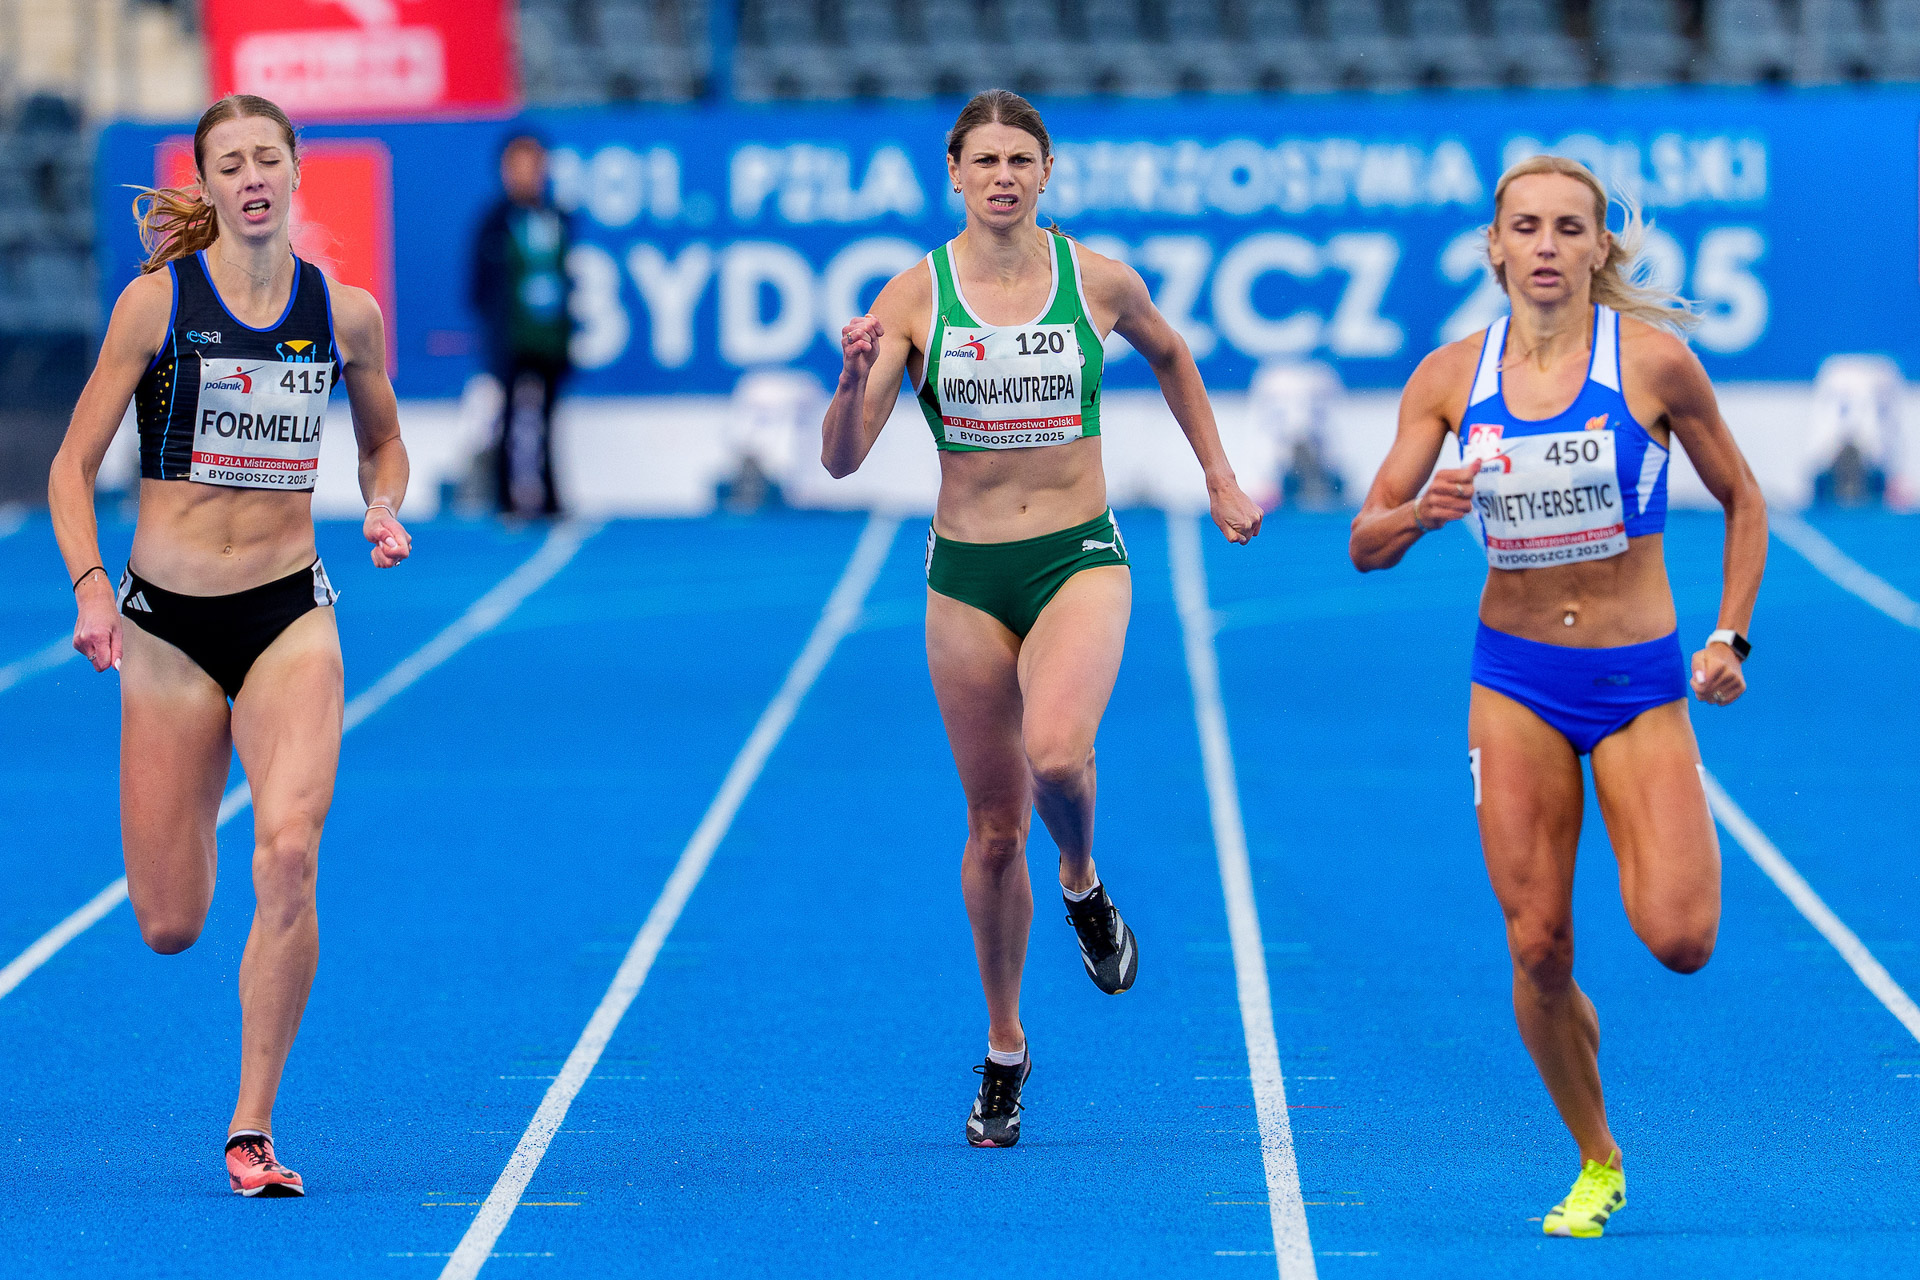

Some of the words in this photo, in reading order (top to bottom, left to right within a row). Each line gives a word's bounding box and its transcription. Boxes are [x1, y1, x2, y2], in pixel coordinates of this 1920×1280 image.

[730, 143, 924, 224] PZLA
[1015, 331, 1065, 356] 120
[944, 349, 975, 359] polanik
[204, 380, 242, 391] polanik
[279, 369, 327, 395] 415
[943, 374, 1075, 405] WRONA-KUTRZEPA
[200, 409, 321, 443] FORMELLA
[949, 417, 965, 427] 101.
[966, 419, 986, 430] PZLA
[987, 418, 1046, 431] Mistrzostwa
[1047, 416, 1074, 427] Polski
[960, 431, 1032, 445] BYDGOSZCZ
[1035, 431, 1065, 443] 2025
[1545, 439, 1599, 465] 450
[200, 453, 217, 464] 101.
[218, 456, 241, 467] PZLA
[243, 457, 299, 470] Mistrzostwa
[299, 458, 315, 470] Polski
[208, 469, 285, 485] BYDGOSZCZ
[287, 474, 307, 485] 2025
[1576, 543, 1609, 557] 2025
